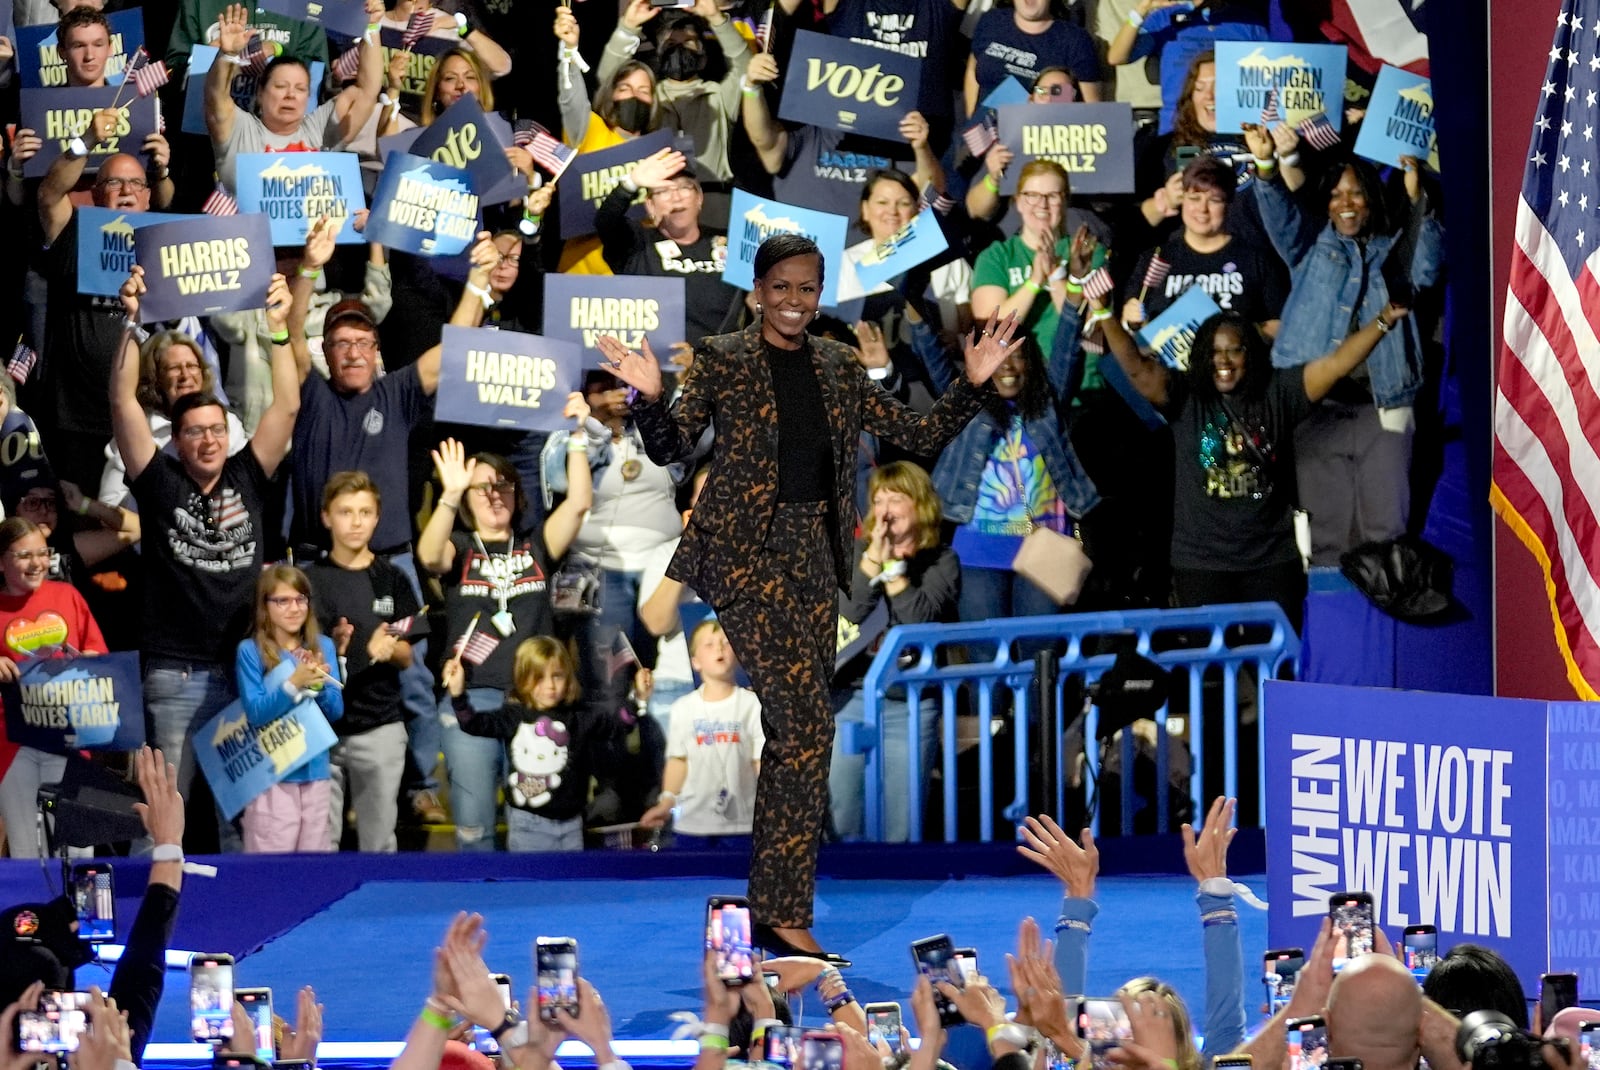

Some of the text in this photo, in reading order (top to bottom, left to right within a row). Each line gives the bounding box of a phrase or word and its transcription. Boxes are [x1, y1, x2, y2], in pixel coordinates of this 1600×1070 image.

[807, 58, 905, 107] vote
[1240, 66, 1323, 90] MICHIGAN
[1285, 91, 1325, 111] EARLY
[431, 122, 482, 170] ote
[1022, 124, 1108, 155] HARRIS
[1386, 116, 1431, 149] VOTES
[814, 165, 868, 183] WALZ
[1035, 154, 1096, 172] ALZ
[262, 175, 343, 198] MICHIGAN
[395, 176, 479, 220] MICHIGAN
[259, 198, 348, 220] VOTES EARLY
[387, 199, 478, 242] VOTES EARLY
[160, 237, 251, 278] HARRIS
[177, 271, 241, 296] WALZ
[571, 297, 659, 331] HARRIS
[466, 351, 557, 391] HARRIS
[478, 383, 541, 409] WALZ
[195, 558, 231, 573] 2024
[460, 584, 489, 598] SAVE
[20, 677, 115, 707] MICHIGAN
[20, 702, 120, 730] VOTES EARLY
[224, 714, 305, 784] VOTES EARLY
[1344, 737, 1513, 838] WE VOTE
[1291, 733, 1341, 918] WHEN
[1342, 827, 1512, 938] WE WIN
